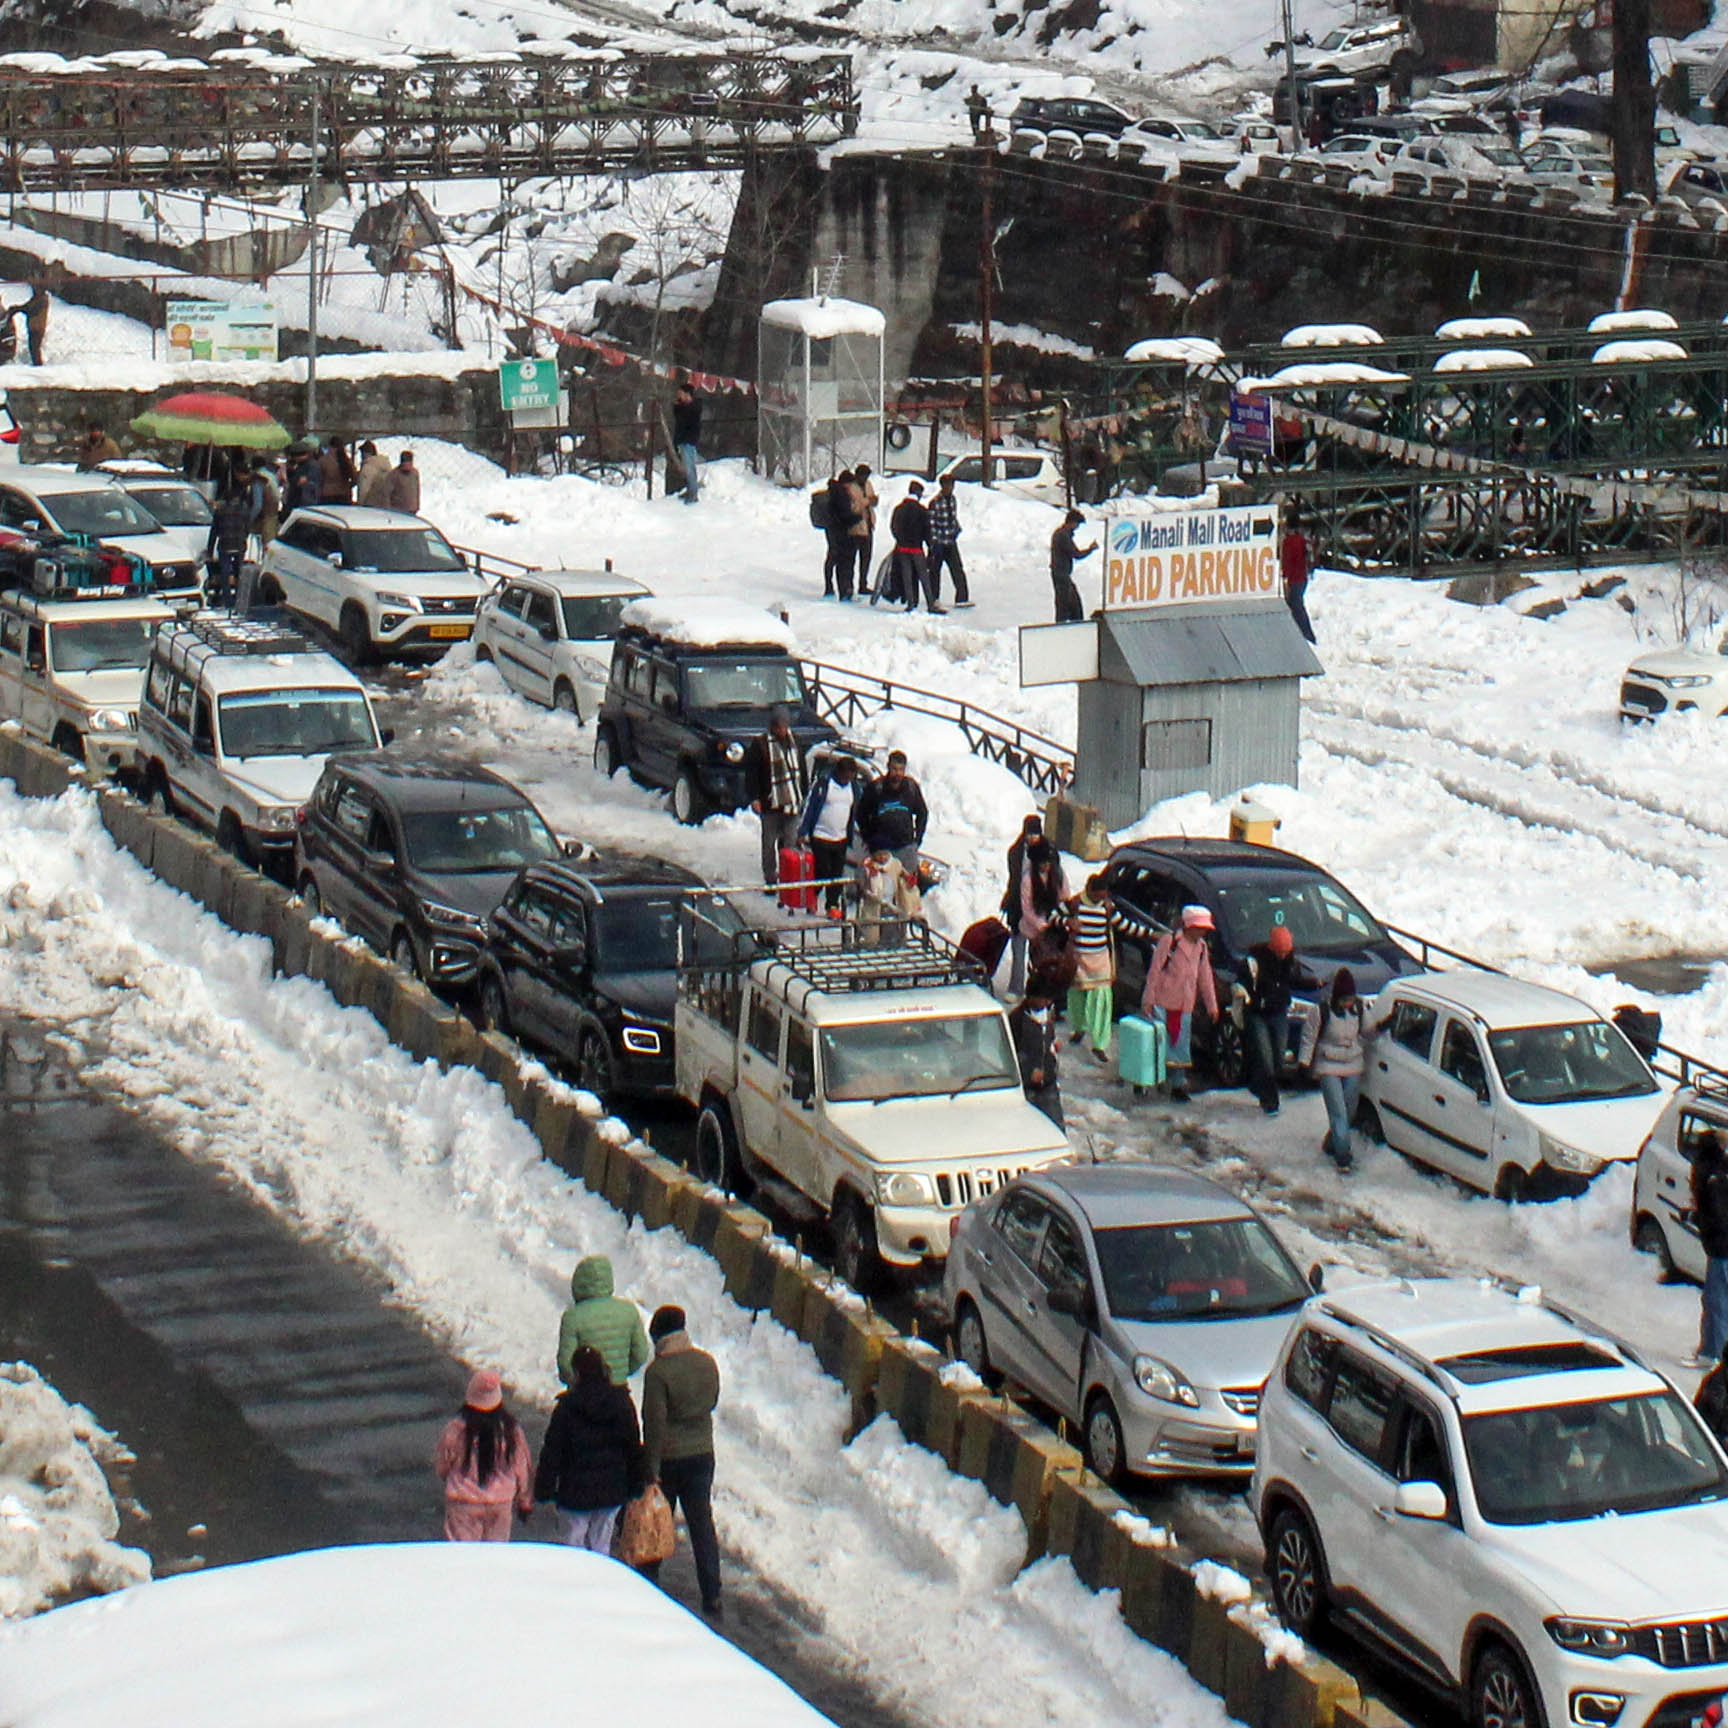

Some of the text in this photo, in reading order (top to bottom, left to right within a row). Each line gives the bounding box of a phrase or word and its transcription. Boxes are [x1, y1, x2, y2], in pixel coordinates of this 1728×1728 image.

[520, 382, 538, 393] NO
[1140, 512, 1251, 550] Manali Mall Road
[1108, 546, 1275, 604] PAID PARKING
